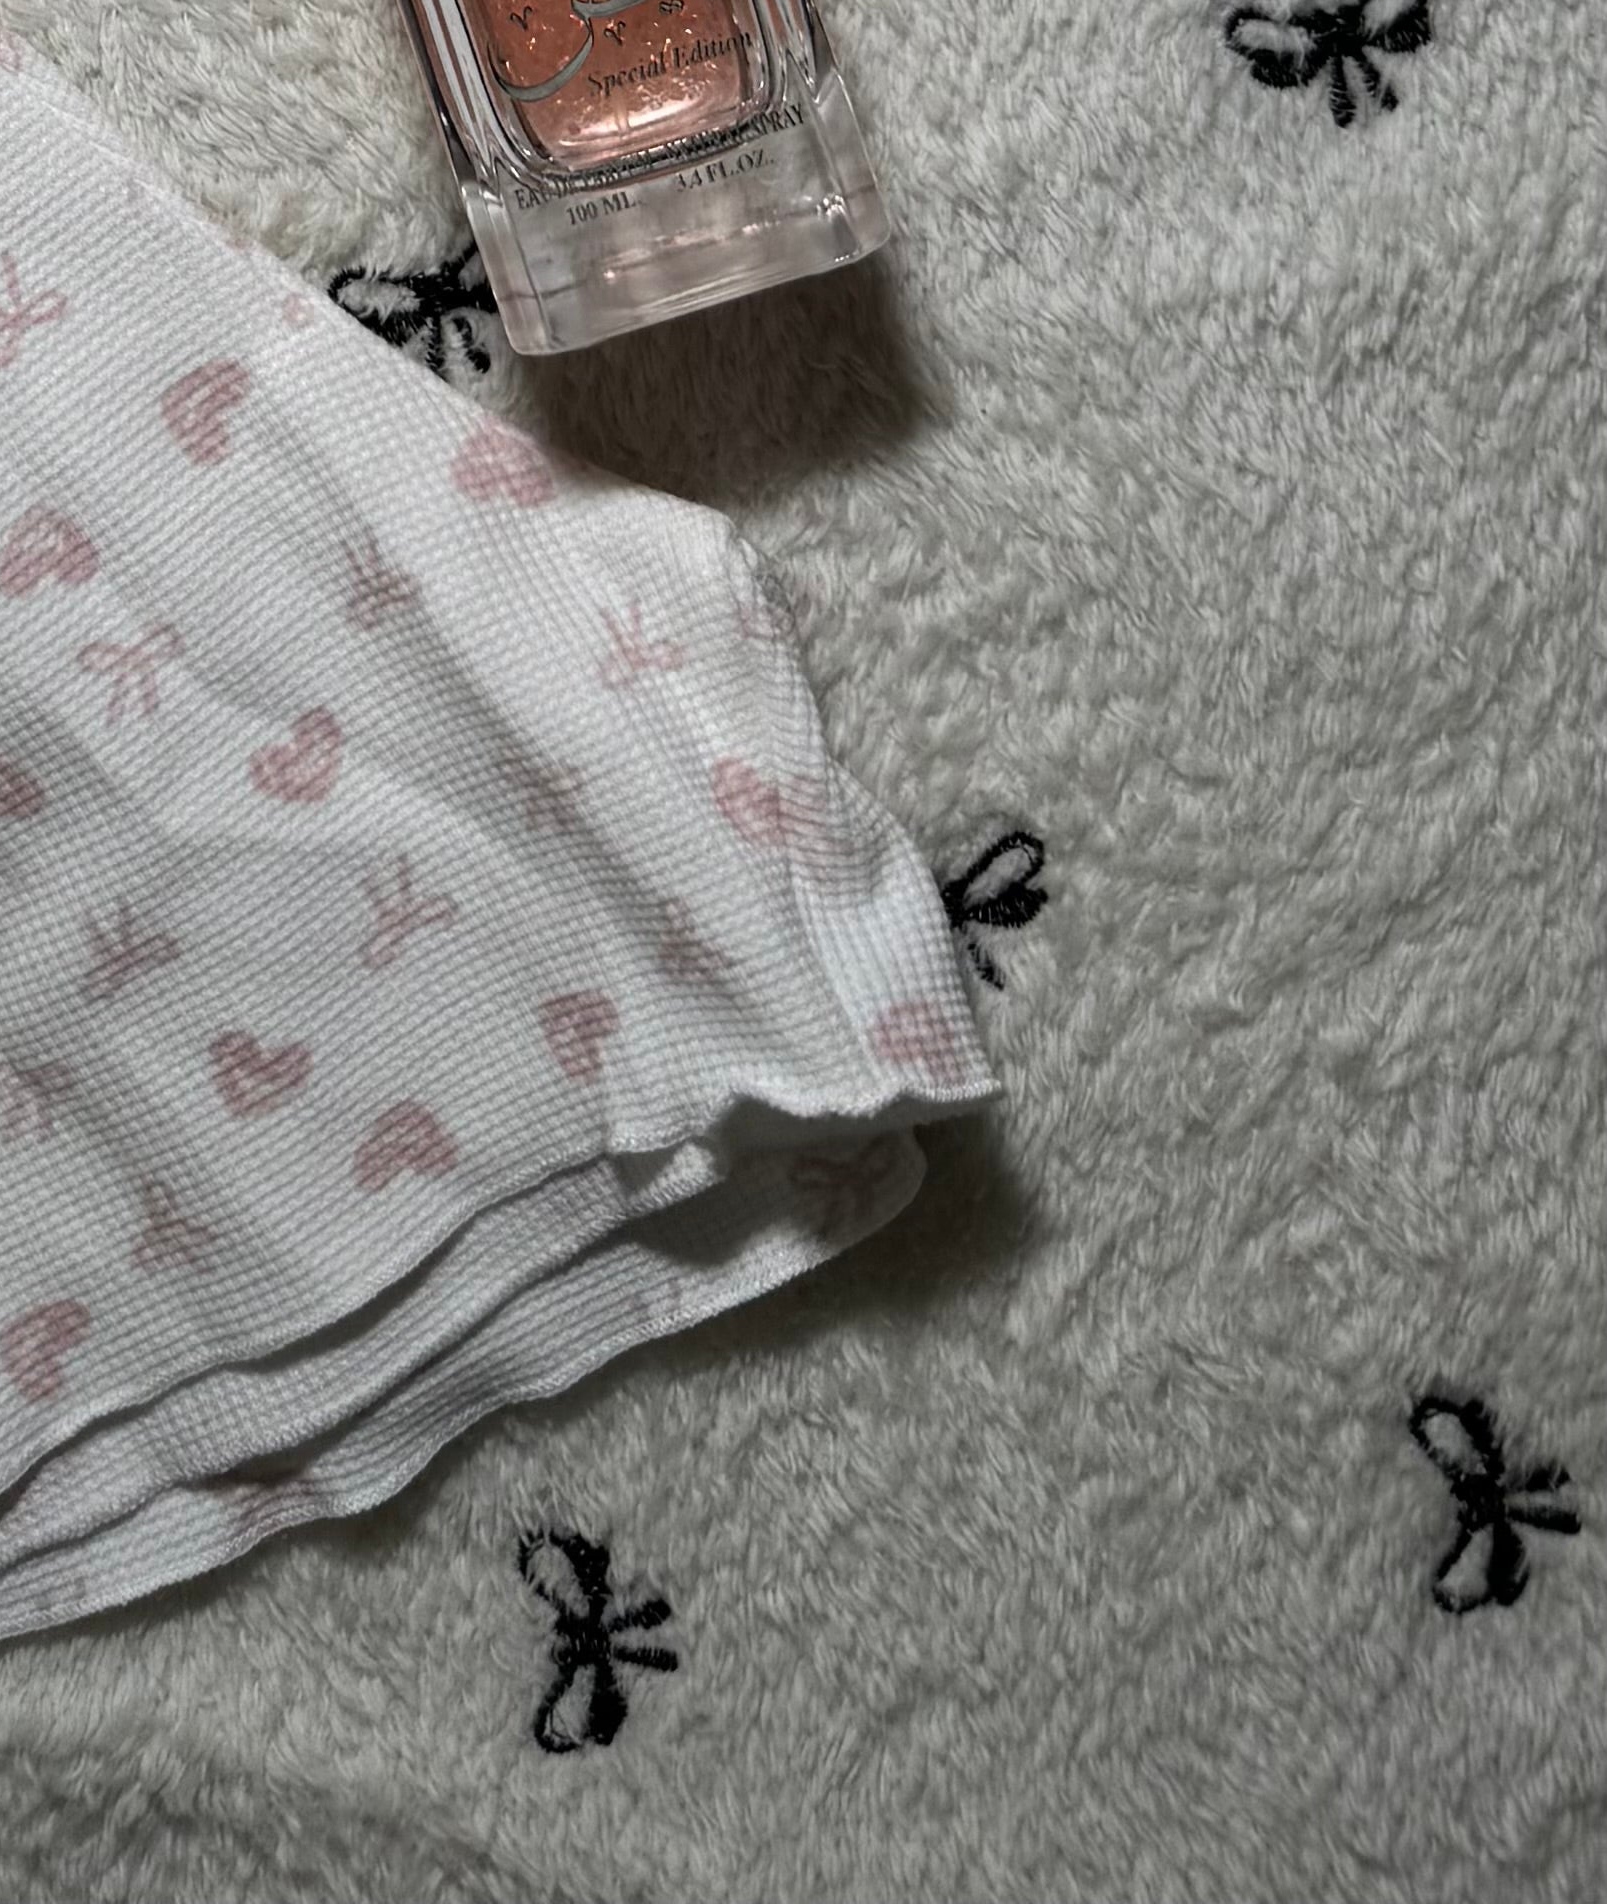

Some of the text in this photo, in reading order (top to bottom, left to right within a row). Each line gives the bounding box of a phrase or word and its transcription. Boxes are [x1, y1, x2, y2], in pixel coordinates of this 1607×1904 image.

[587, 32, 752, 97] Special Edition
[750, 103, 805, 136] SPRAY
[566, 203, 599, 225] 100
